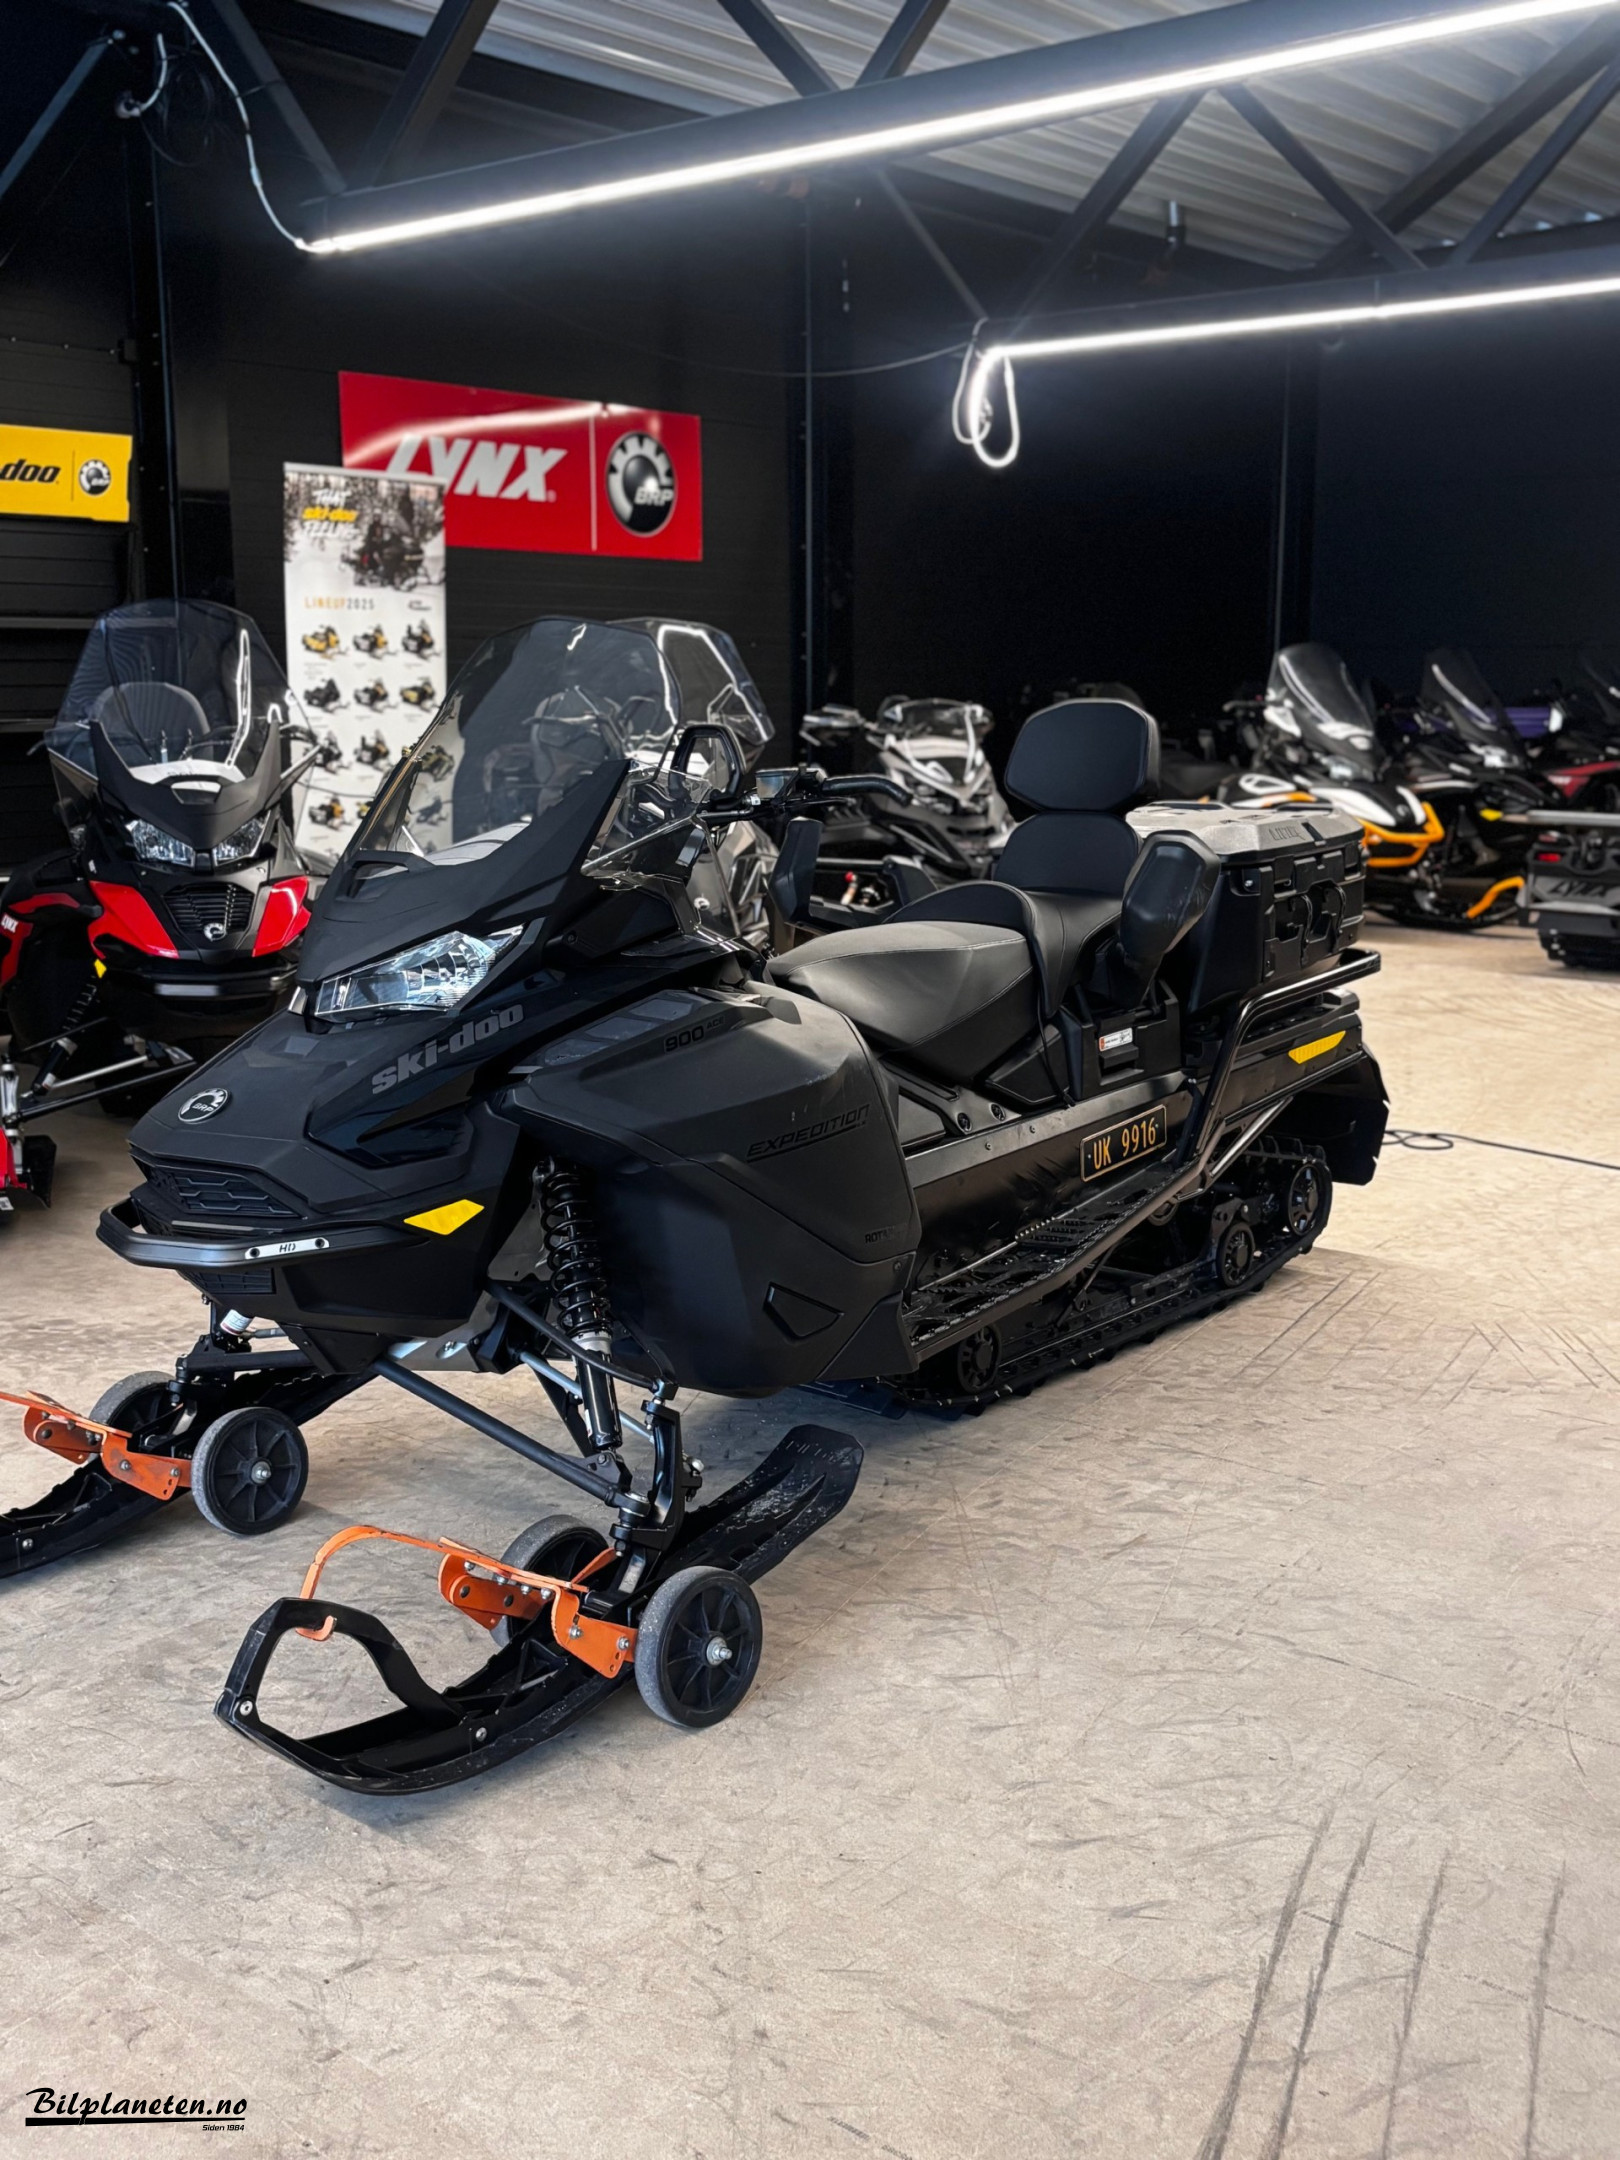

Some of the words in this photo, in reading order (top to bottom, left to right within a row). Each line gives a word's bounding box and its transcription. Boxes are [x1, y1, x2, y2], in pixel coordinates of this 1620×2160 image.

[385, 432, 568, 502] LYNX
[634, 486, 674, 505] BRP
[665, 1025, 704, 1052] 900
[192, 1103, 214, 1112] BRP
[746, 1104, 870, 1157] EXPEDITION
[1093, 1135, 1111, 1170] UK
[1121, 1117, 1156, 1157] 9916
[279, 1243, 296, 1253] HD
